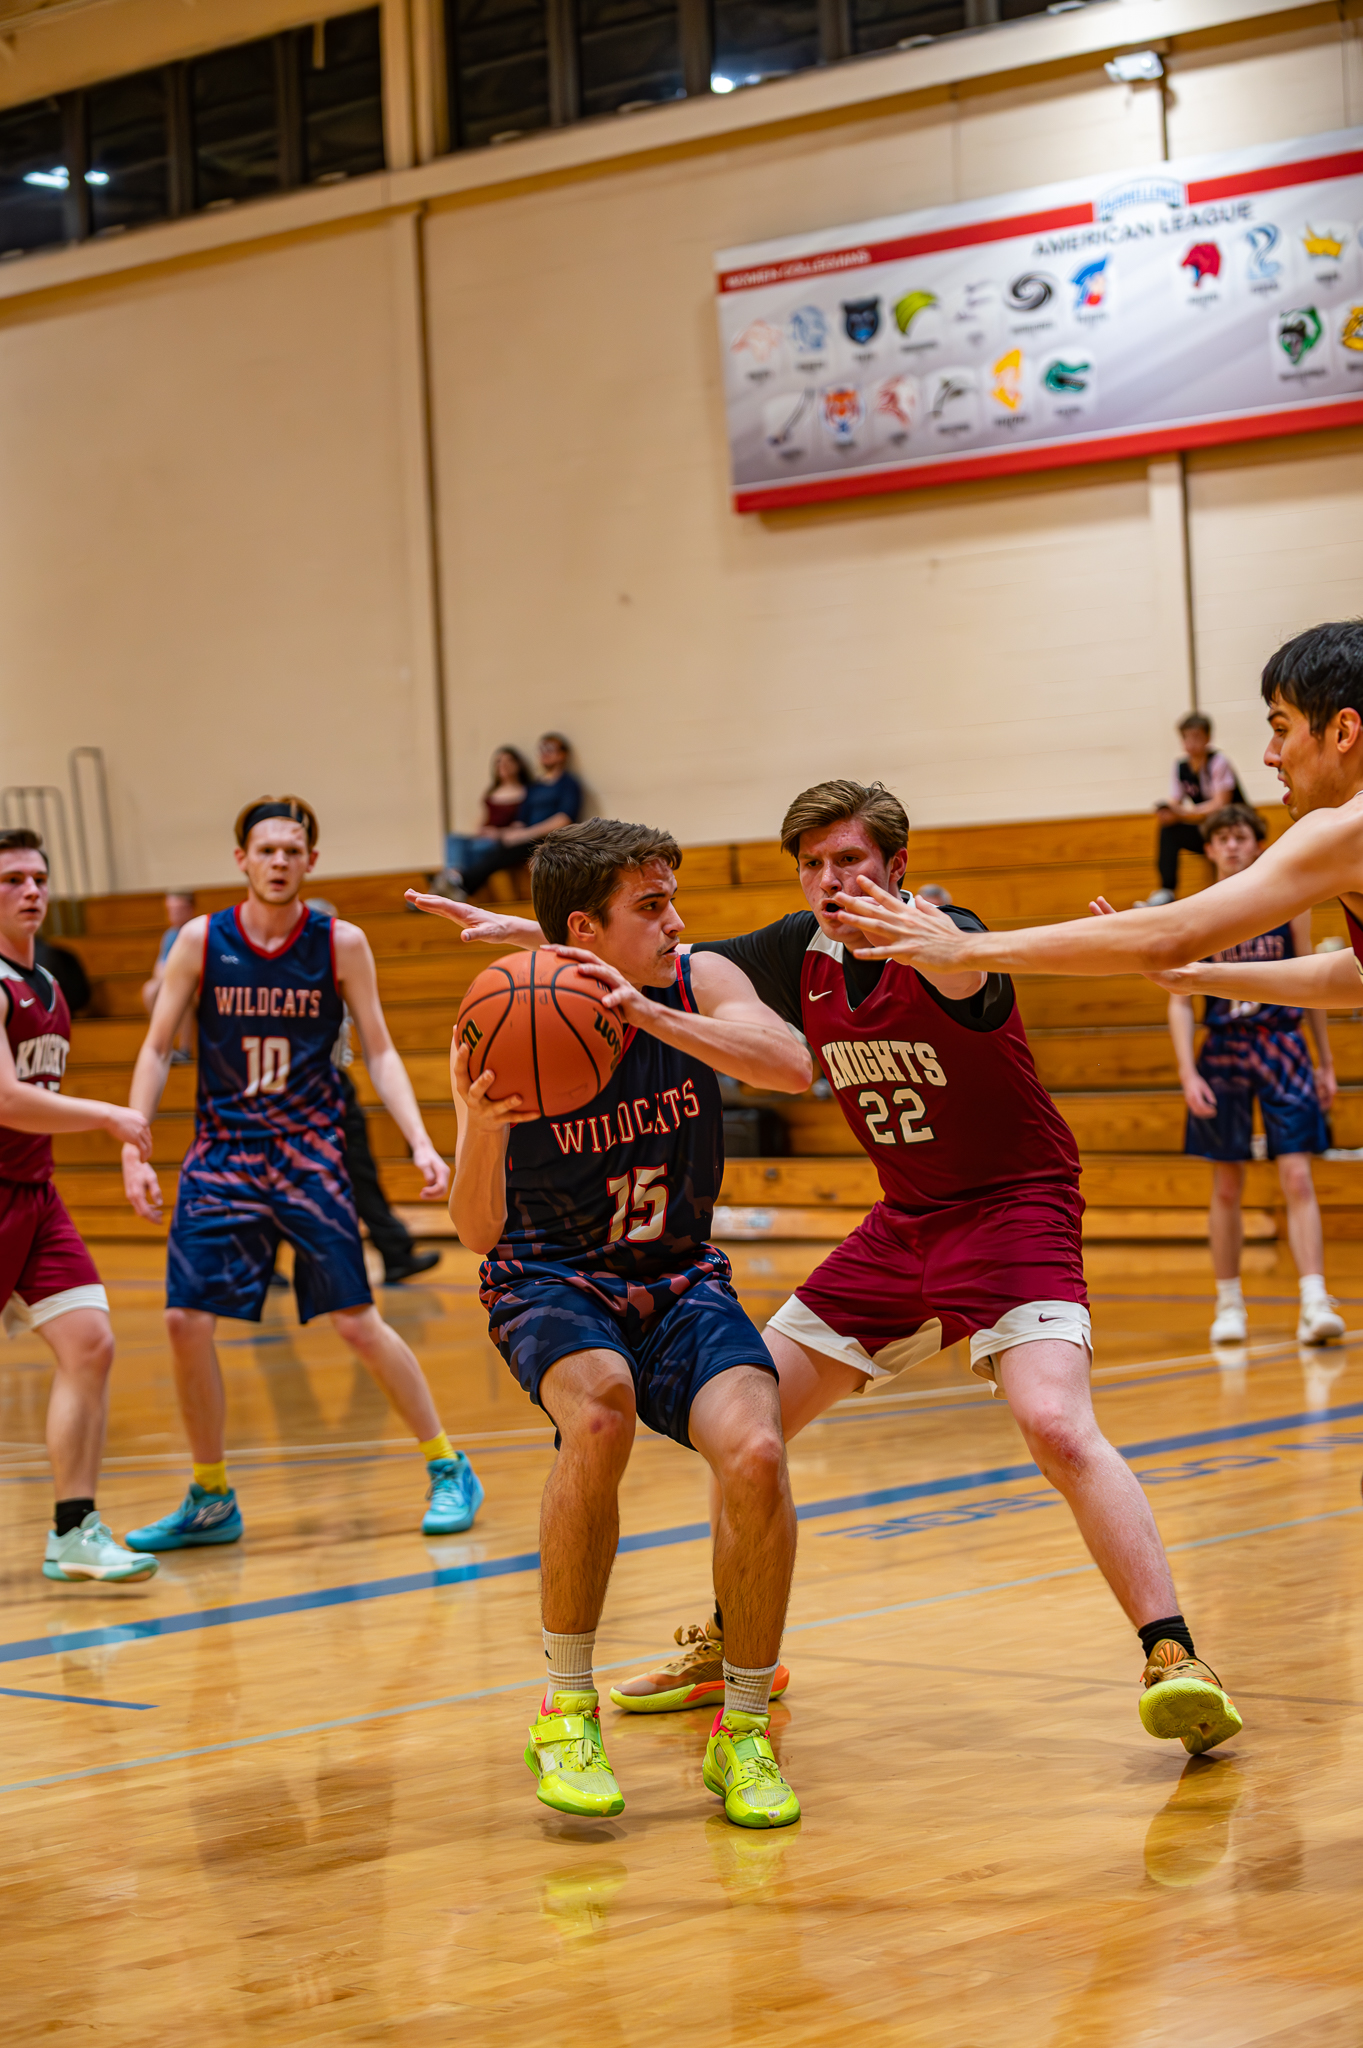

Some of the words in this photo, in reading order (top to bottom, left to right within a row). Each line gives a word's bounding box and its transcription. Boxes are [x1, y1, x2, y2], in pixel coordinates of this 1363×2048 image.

[1034, 222, 1154, 256] AMERICAN
[1159, 201, 1252, 236] LEAGUE
[214, 986, 322, 1018] WILDCATS
[241, 1035, 291, 1097] 10
[821, 1040, 947, 1090] KNIGHTS
[550, 1078, 700, 1154] WILDCATS
[858, 1087, 936, 1144] 22
[606, 1162, 669, 1243] 15
